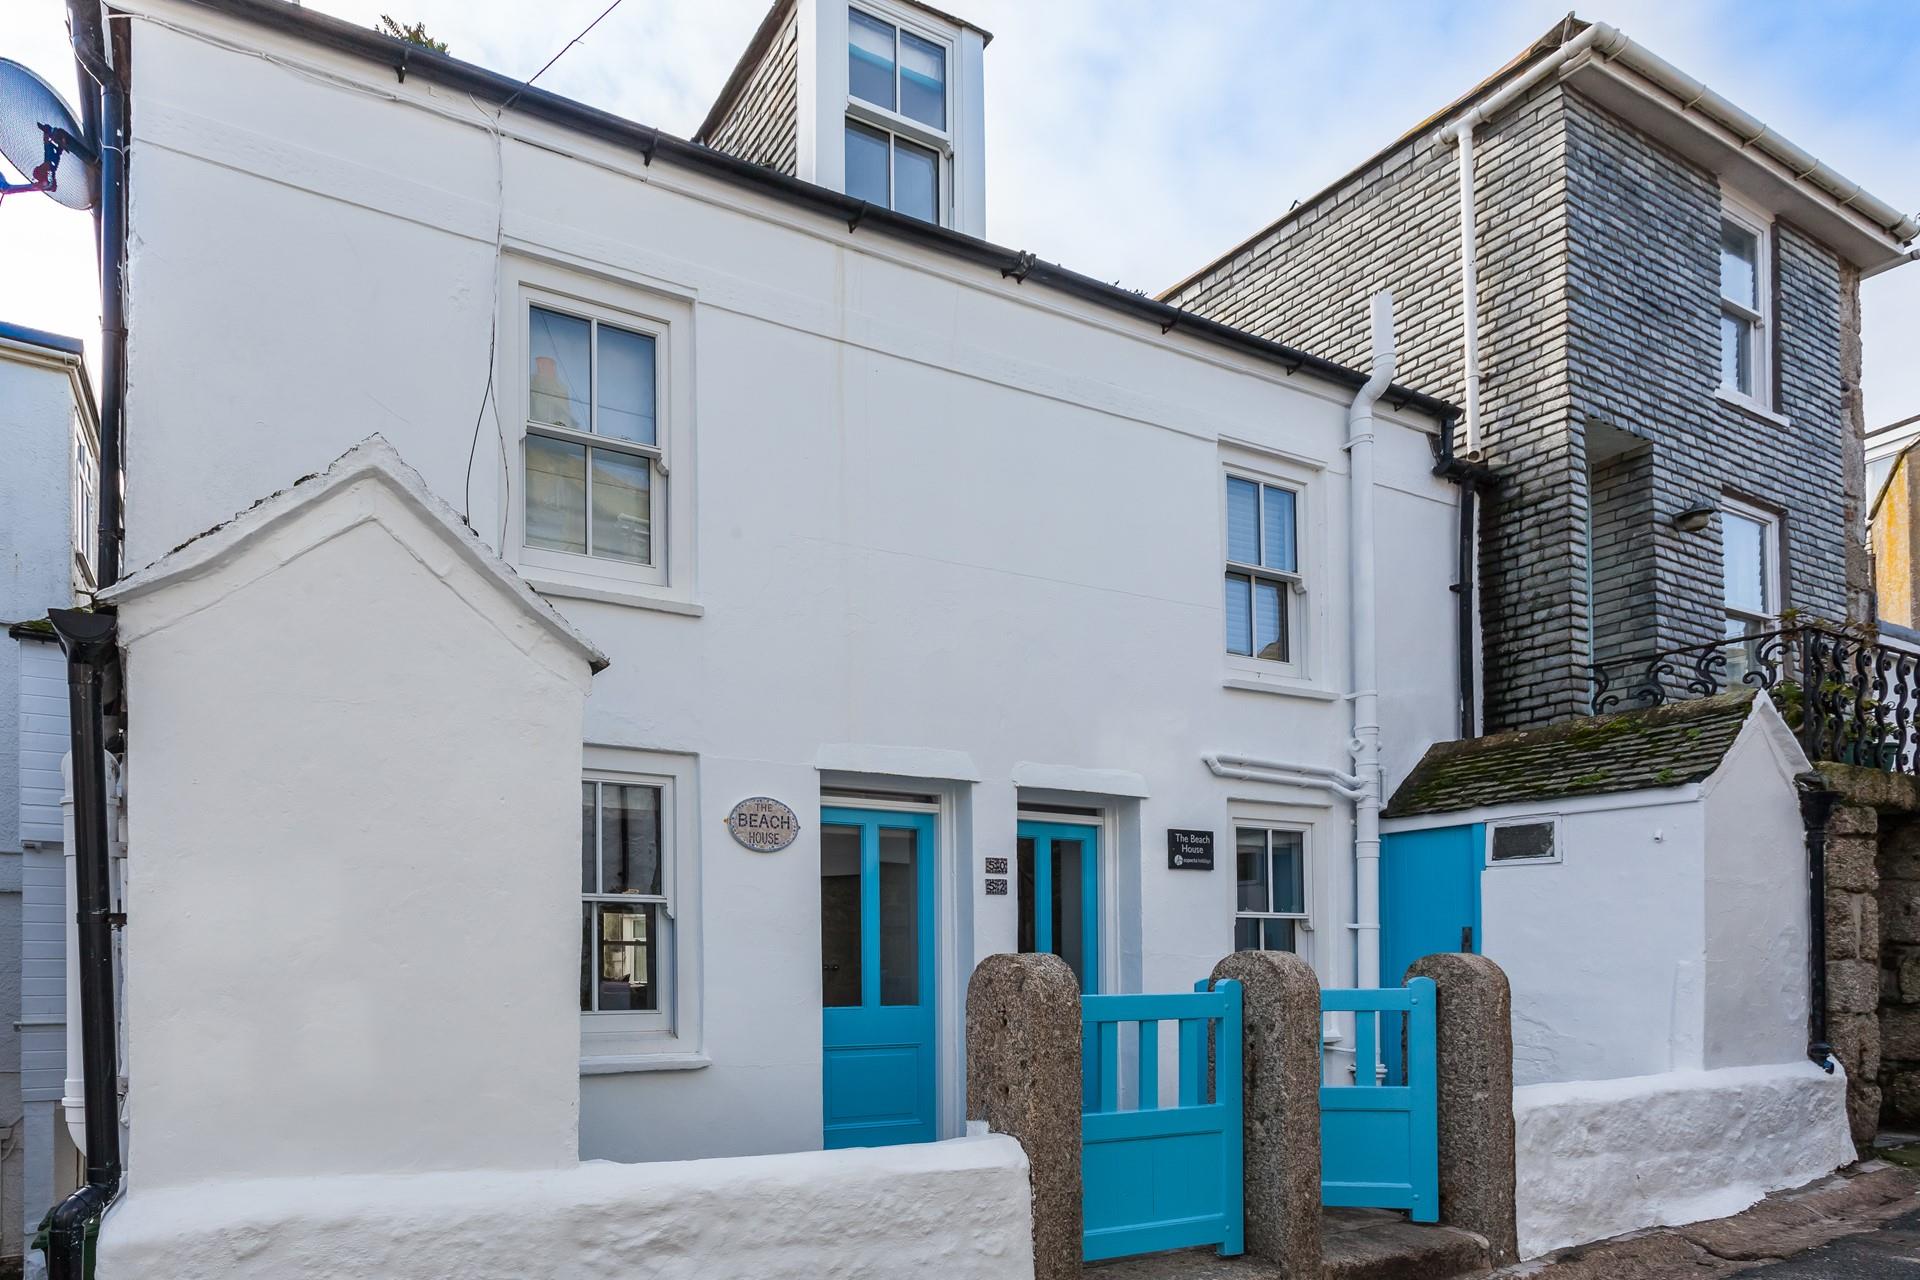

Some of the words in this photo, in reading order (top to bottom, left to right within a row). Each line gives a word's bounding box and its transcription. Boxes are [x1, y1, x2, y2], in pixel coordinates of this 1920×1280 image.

[755, 803, 773, 812] THE
[738, 813, 790, 830] BEACH
[748, 832, 780, 845] HOUSE
[1175, 833, 1189, 843] The
[1190, 834, 1211, 844] Beach
[1181, 844, 1204, 854] House
